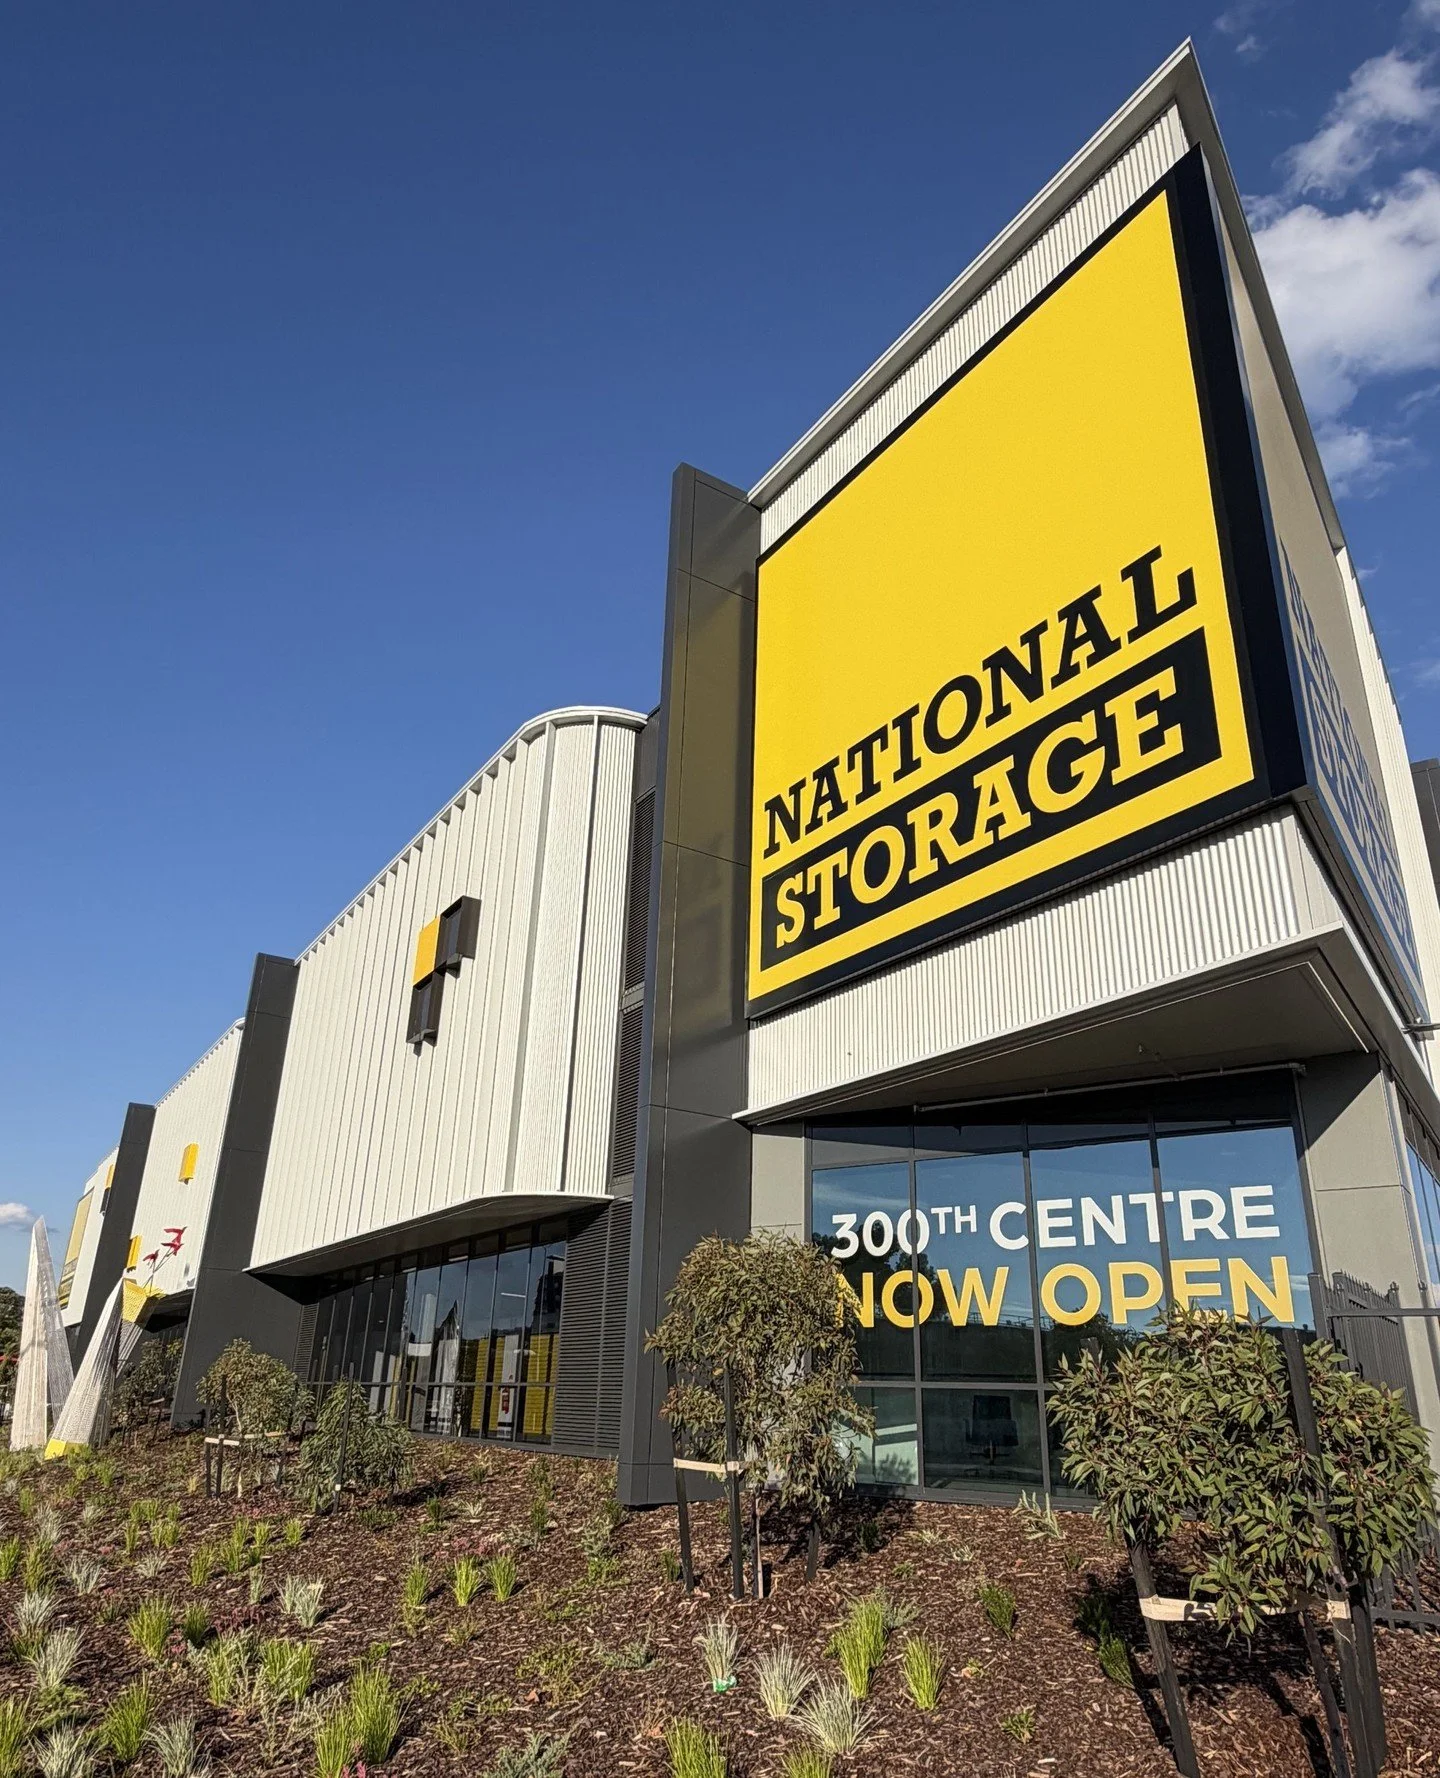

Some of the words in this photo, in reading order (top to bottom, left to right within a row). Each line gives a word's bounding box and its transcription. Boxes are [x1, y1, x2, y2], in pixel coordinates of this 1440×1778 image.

[763, 545, 1198, 860] NATIONAL
[776, 666, 1184, 949] STORAGE
[831, 1205, 977, 1258] 300TH
[990, 1185, 1281, 1250] CENTRE
[833, 1267, 1010, 1328] NOW
[1041, 1256, 1295, 1326] OPEN
